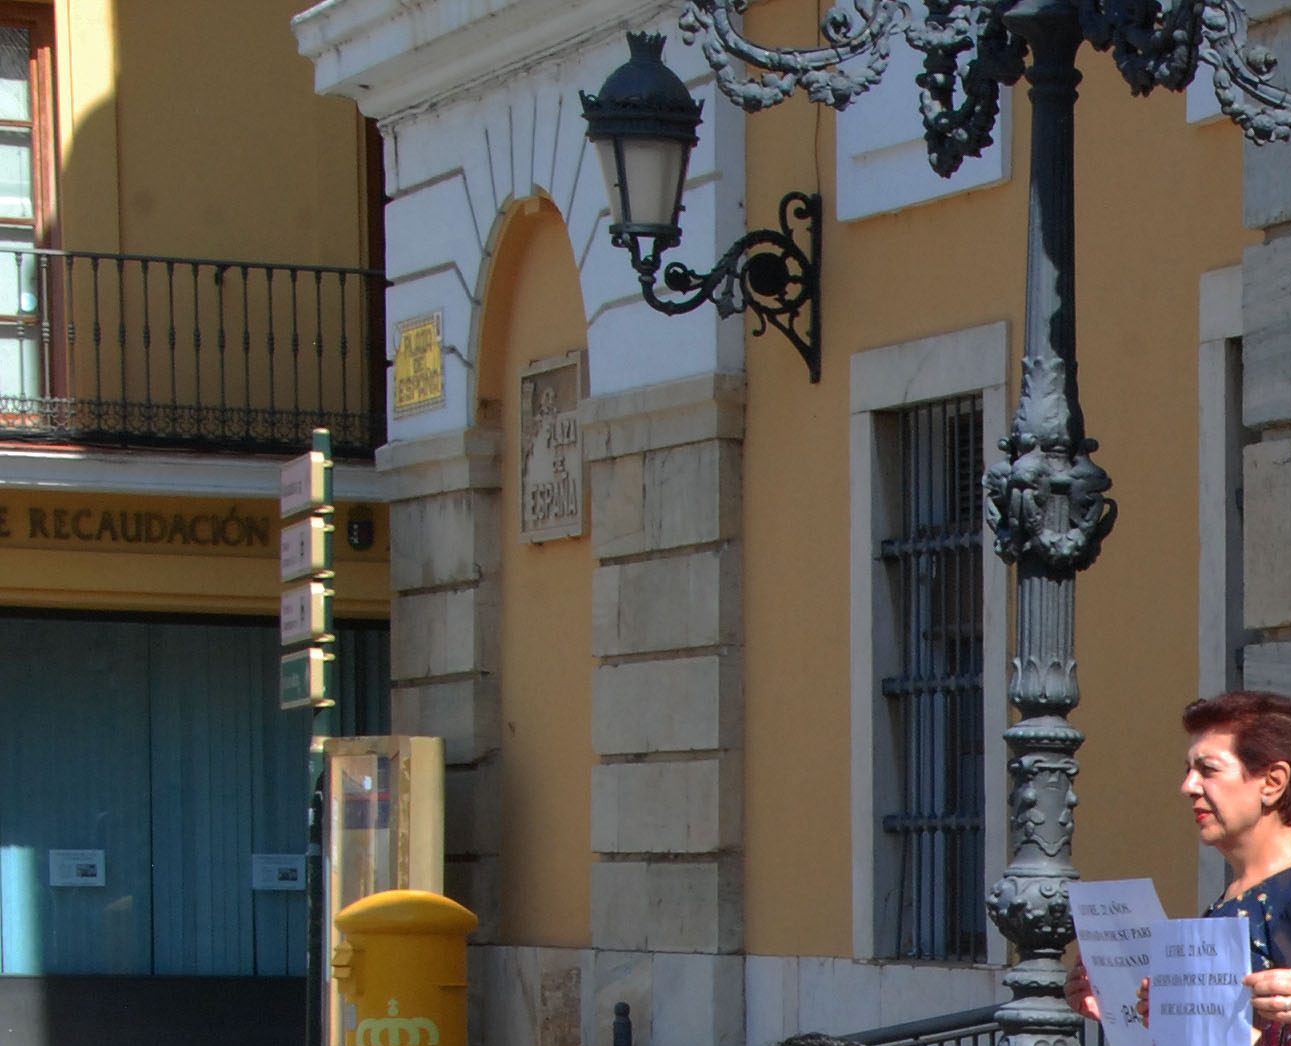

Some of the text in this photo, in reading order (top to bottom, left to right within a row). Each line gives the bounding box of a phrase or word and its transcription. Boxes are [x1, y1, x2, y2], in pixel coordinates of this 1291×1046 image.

[403, 327, 433, 356] PLAZA
[398, 368, 441, 403] ESPAÑA
[546, 416, 577, 449] PLAZA
[552, 455, 565, 474] DE
[530, 472, 578, 522] ESPAÑA
[28, 504, 270, 547] RECAUDACIÓN
[1208, 972, 1238, 985] PAREJA
